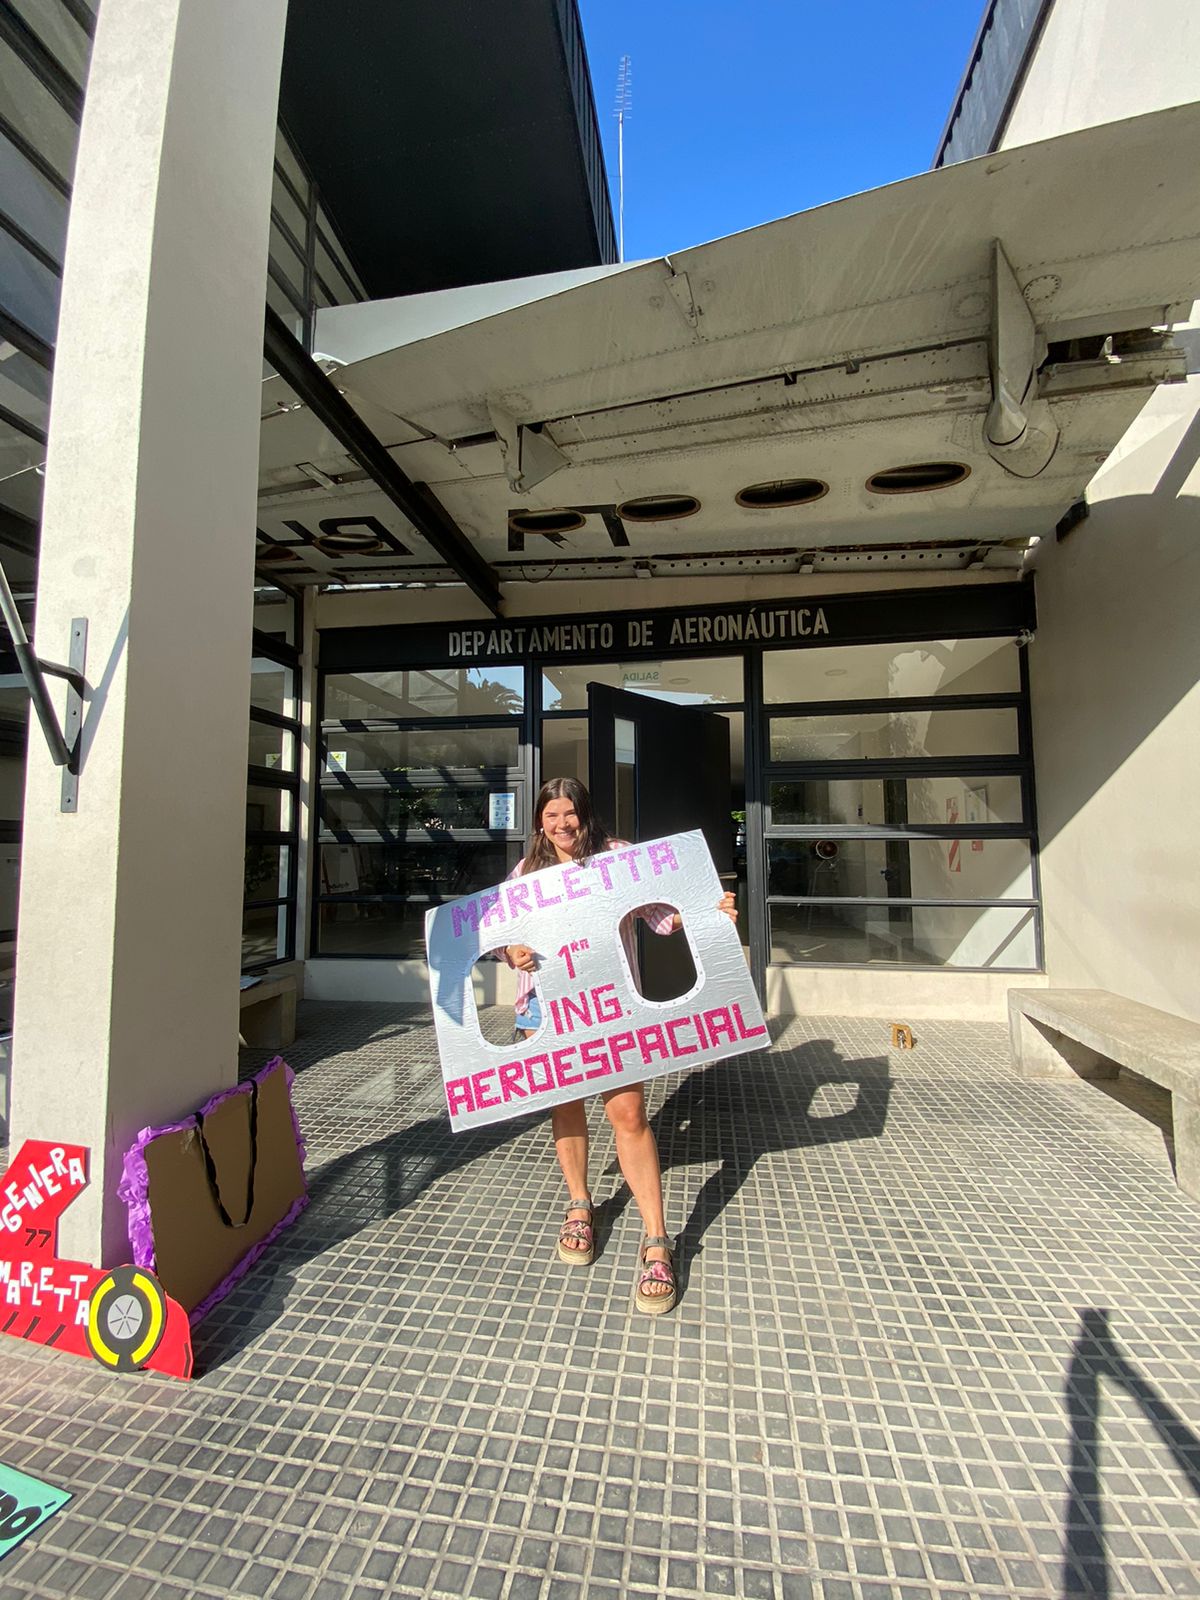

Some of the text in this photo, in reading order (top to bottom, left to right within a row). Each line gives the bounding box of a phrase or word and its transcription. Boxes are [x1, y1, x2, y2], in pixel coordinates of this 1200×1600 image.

[448, 607, 829, 657] DEPARTAMENTO DE AERONÁUTICA
[452, 839, 679, 938] MARLETTA
[550, 982, 632, 1036] ING.
[445, 1002, 766, 1117] AEROESPACIAL
[0, 1147, 87, 1232] GENIERA
[25, 1228, 52, 1248] 77
